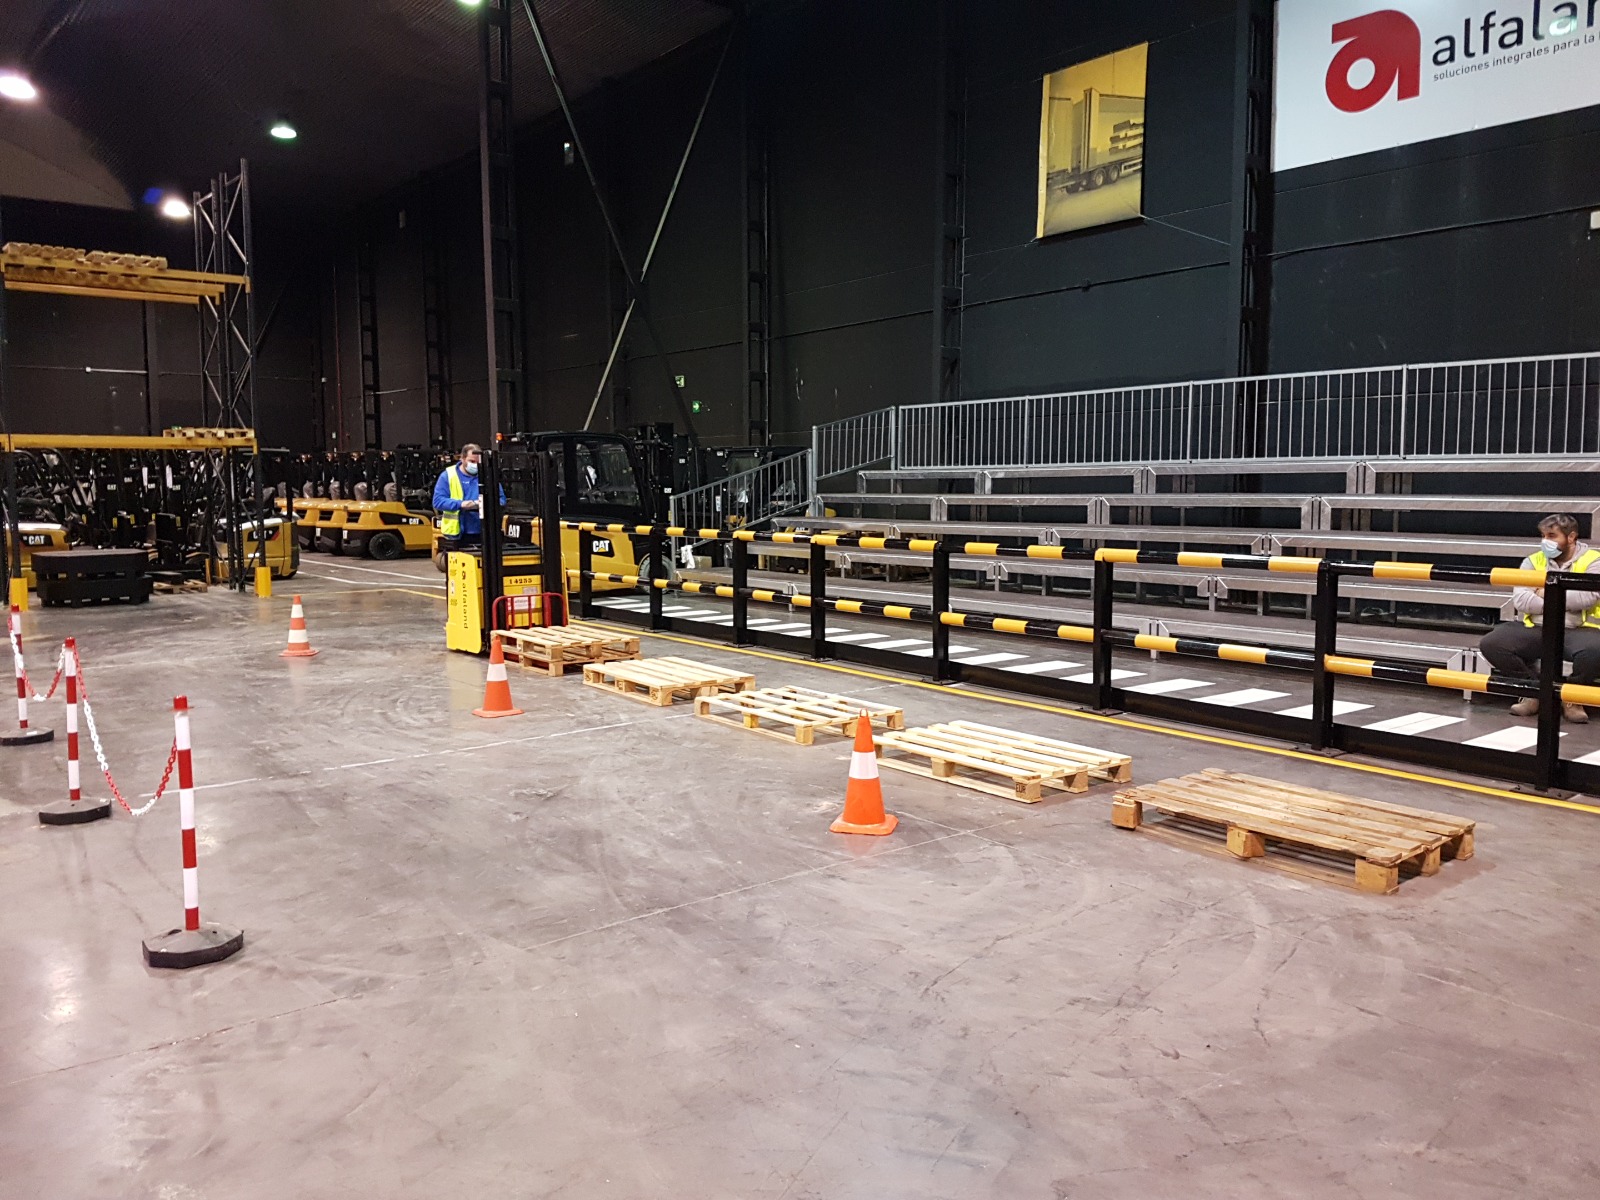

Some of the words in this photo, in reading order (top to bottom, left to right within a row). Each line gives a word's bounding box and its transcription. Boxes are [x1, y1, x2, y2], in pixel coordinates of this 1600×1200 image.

[1433, 61, 1490, 81] soluciones
[1492, 46, 1550, 67] integrales
[1553, 38, 1580, 54] para
[1584, 34, 1595, 44] la
[28, 535, 45, 545] CAT
[592, 540, 610, 553] CAT
